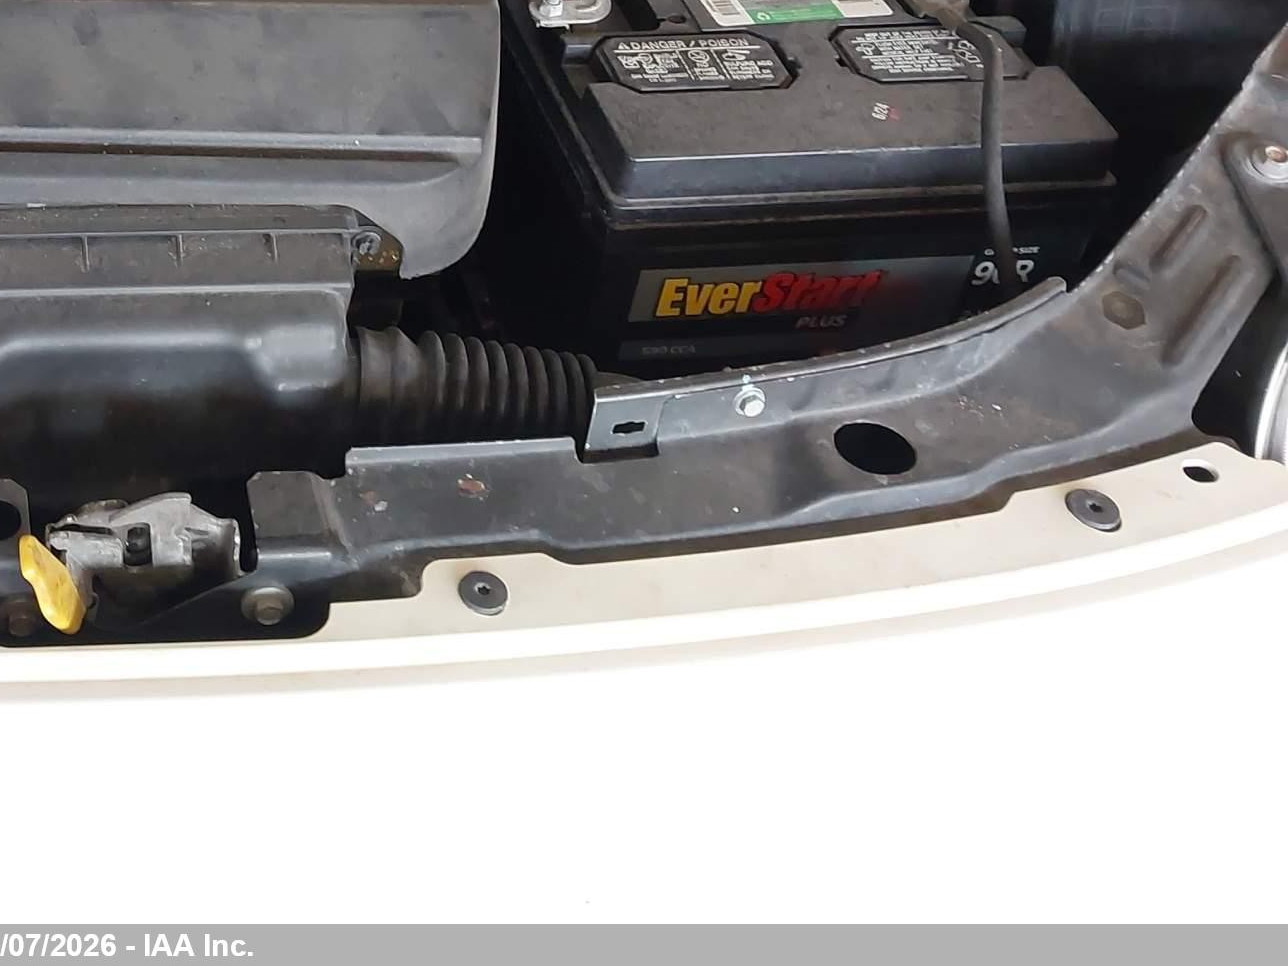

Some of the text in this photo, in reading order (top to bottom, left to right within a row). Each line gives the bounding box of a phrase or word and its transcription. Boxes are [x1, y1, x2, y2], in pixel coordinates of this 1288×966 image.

[630, 40, 687, 50] DANGER
[700, 37, 750, 47] POISON
[655, 269, 884, 318] EverStart
[795, 314, 848, 330] PLUS
